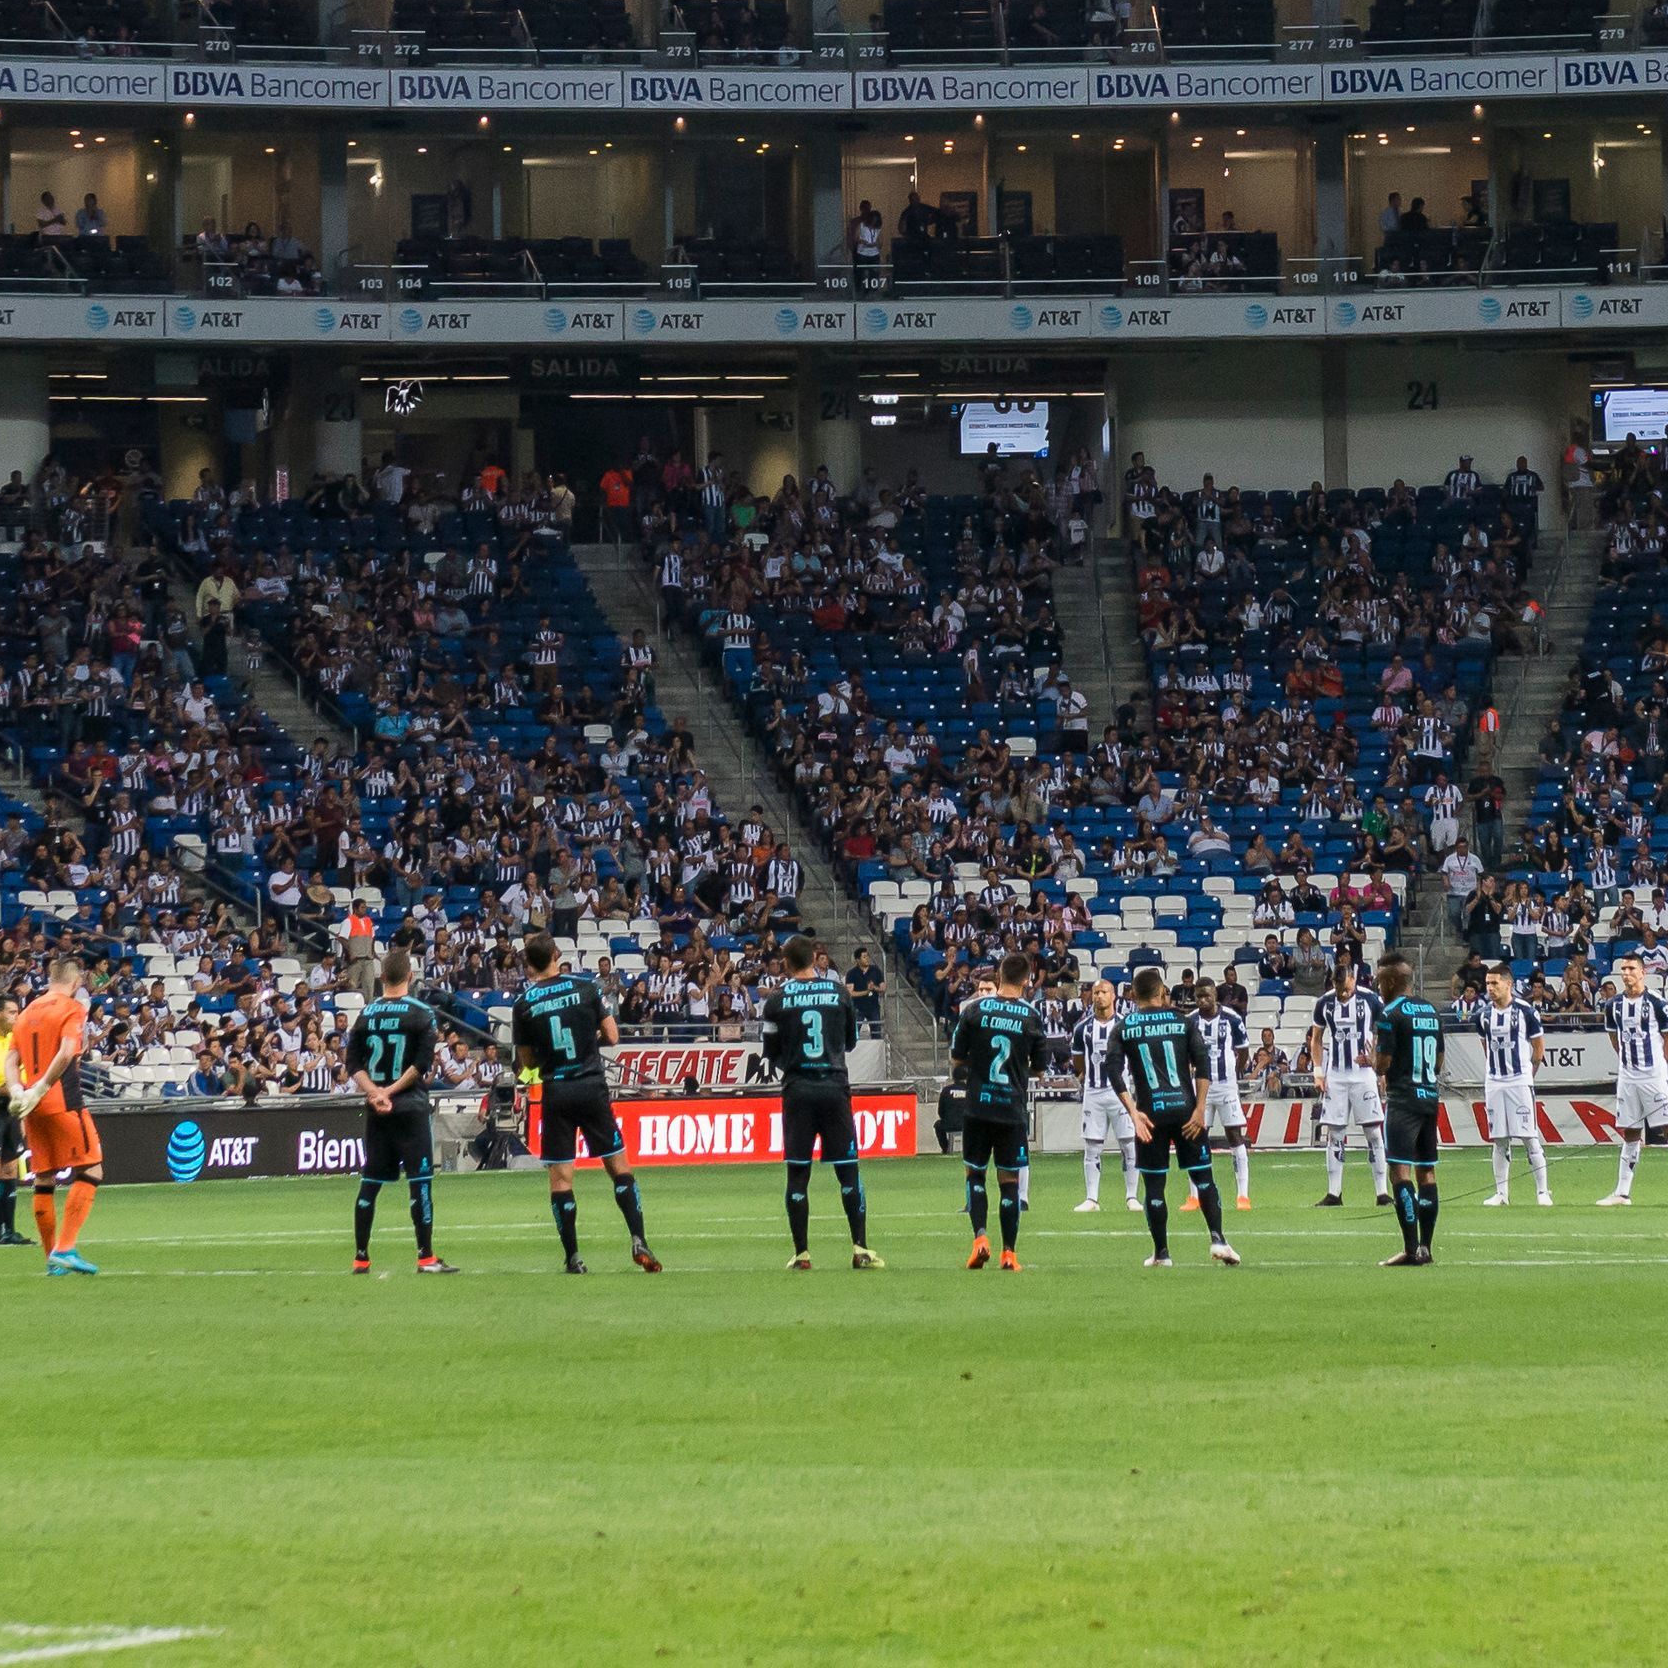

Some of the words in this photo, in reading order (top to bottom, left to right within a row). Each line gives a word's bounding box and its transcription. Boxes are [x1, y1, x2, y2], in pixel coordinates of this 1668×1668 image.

[205, 40, 231, 52] 270
[394, 44, 420, 56] 272
[666, 45, 692, 57] 273
[819, 47, 845, 58] 274
[858, 46, 885, 58] 275
[23, 67, 158, 96] Bancomer
[398, 75, 472, 100] BBVA
[478, 75, 615, 101] Bancomer
[862, 76, 936, 102] BBVA
[942, 76, 1080, 101] Bancomer
[1330, 68, 1404, 94] BBVA
[1410, 67, 1548, 92] Bancomer
[208, 276, 234, 287] 102
[396, 278, 423, 290] 104
[666, 277, 692, 289] 105
[339, 313, 382, 330] AT&T
[802, 313, 847, 329] AT&T
[1361, 305, 1406, 322] AT&T
[1408, 381, 1438, 410] 24
[550, 1016, 576, 1060] 4
[801, 1010, 824, 1058] 3
[990, 1016, 1023, 1034] CORRAL
[1144, 1023, 1185, 1037] SANCHEZ
[366, 1034, 406, 1081] 27
[614, 1049, 745, 1085] TECATE
[990, 1035, 1011, 1084] 2
[1138, 1040, 1181, 1089] 11
[1412, 1036, 1437, 1083] 19
[638, 1112, 754, 1157] HOME
[209, 1136, 259, 1167] AT&T
